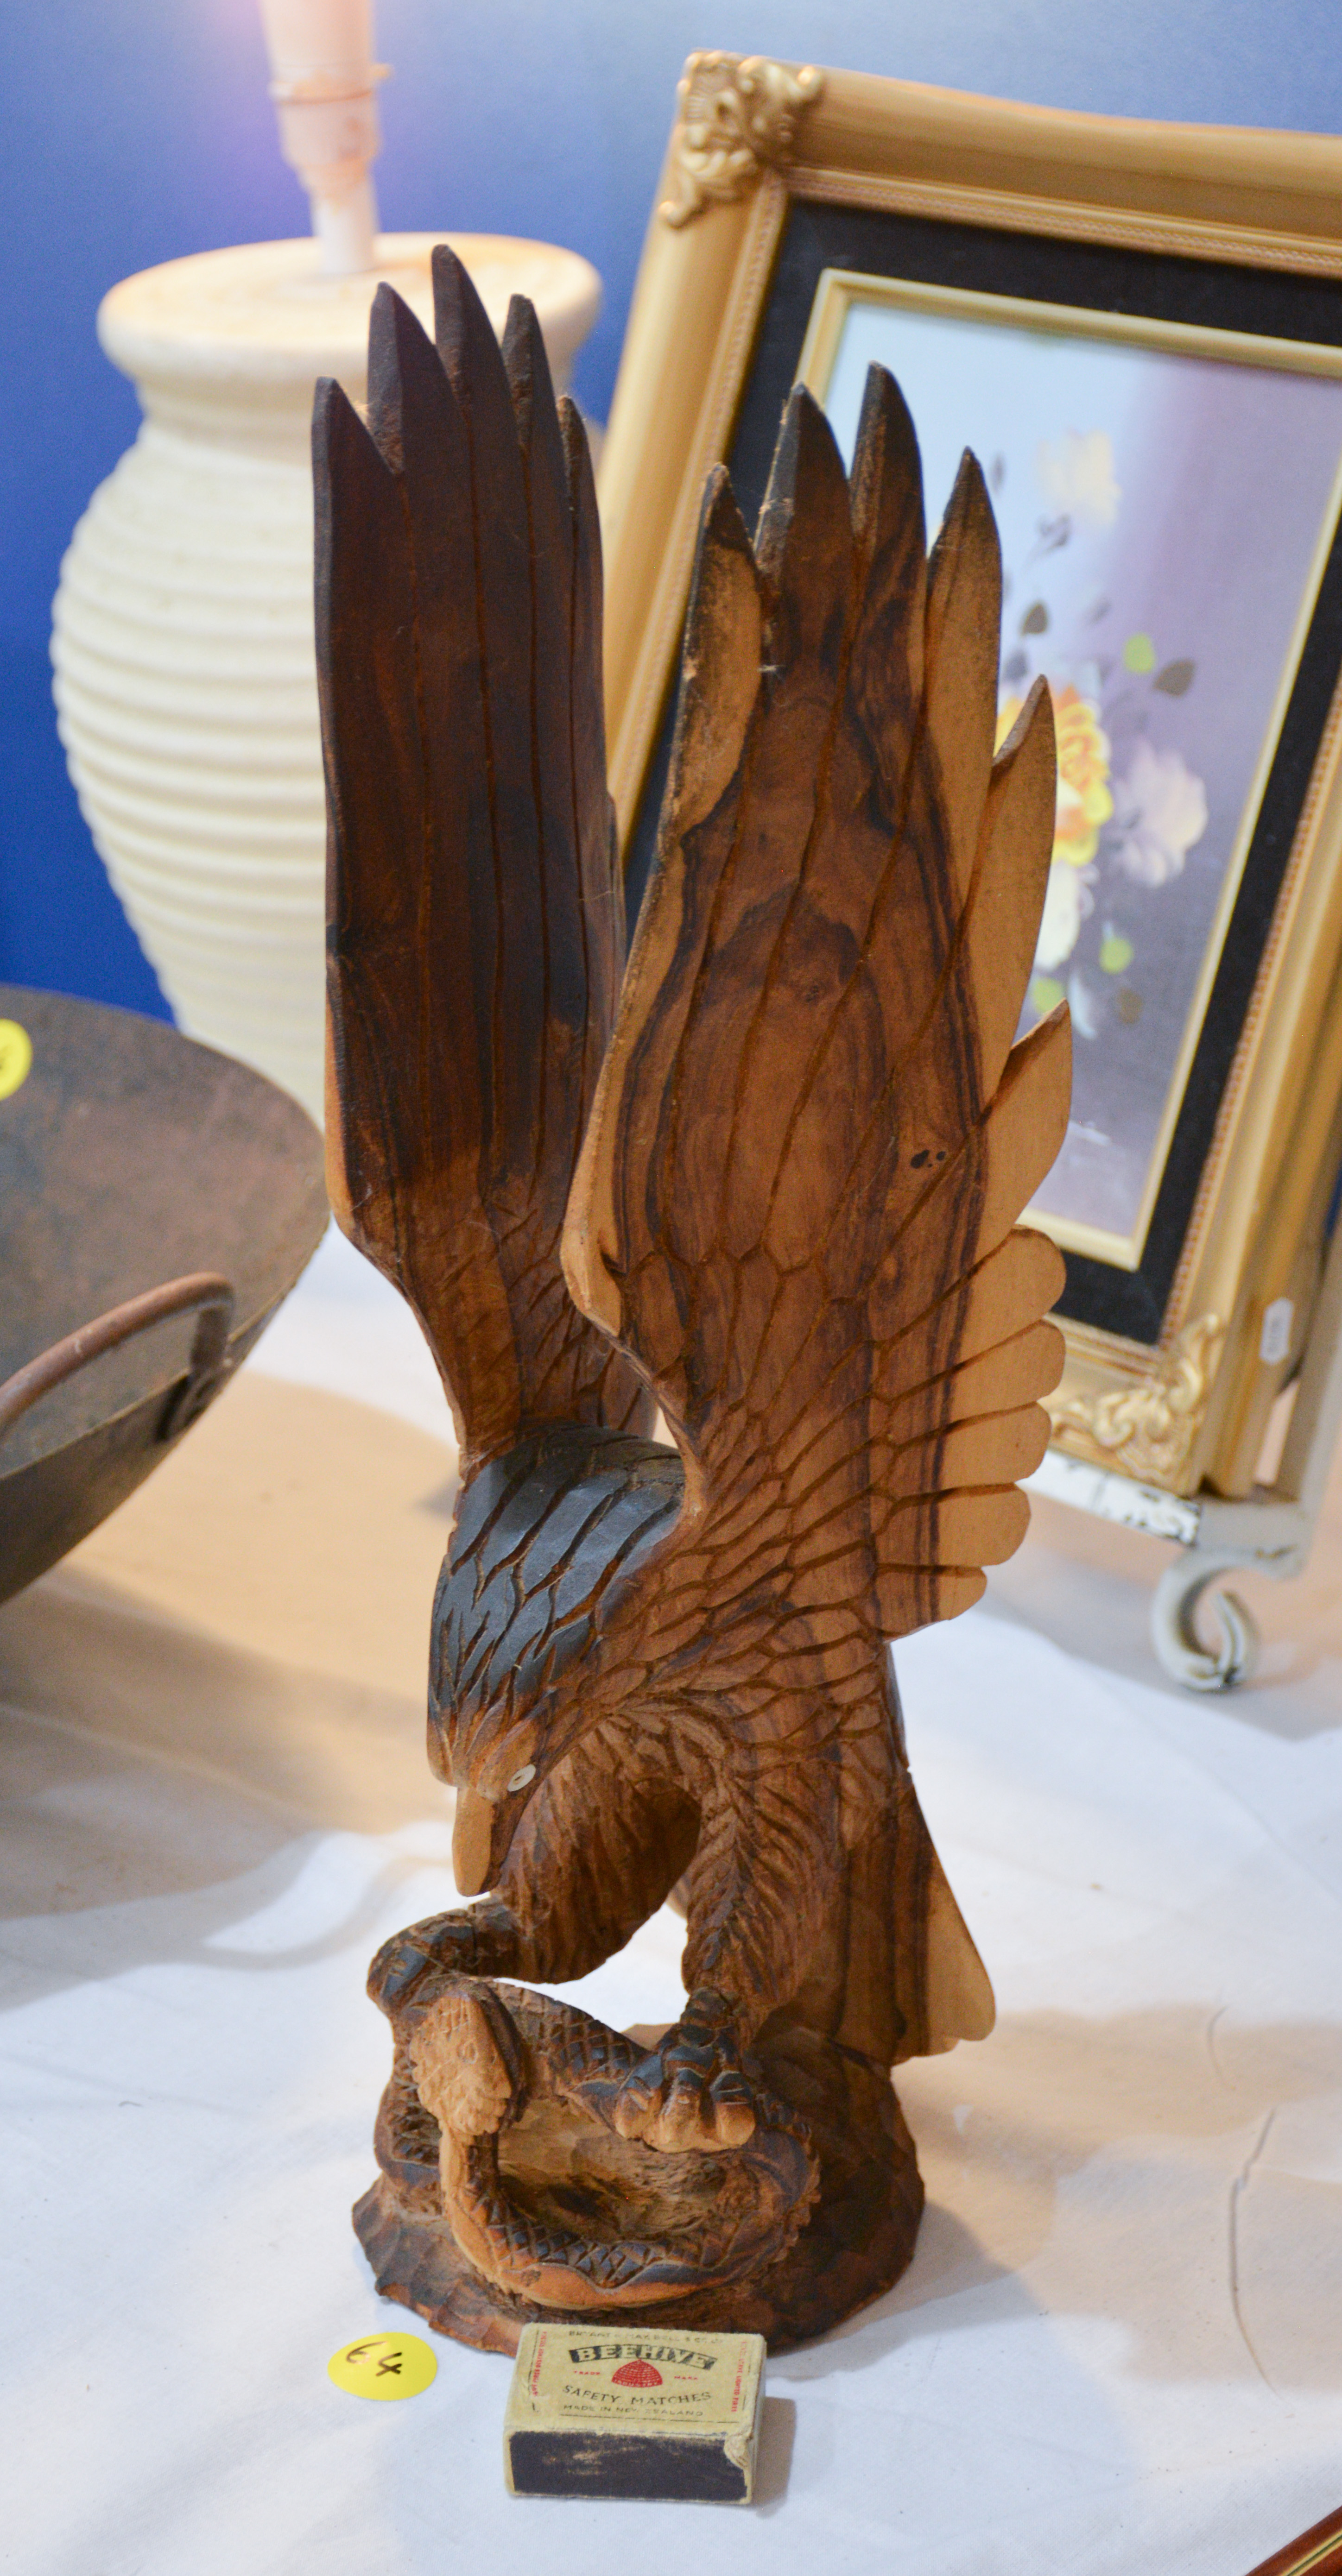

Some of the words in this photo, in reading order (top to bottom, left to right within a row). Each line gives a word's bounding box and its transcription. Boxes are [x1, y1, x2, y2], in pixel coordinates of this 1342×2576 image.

[575, 2344, 712, 2369] BEEHIVE
[563, 2385, 621, 2403] SAFETY
[631, 2392, 711, 2405] MATCHES
